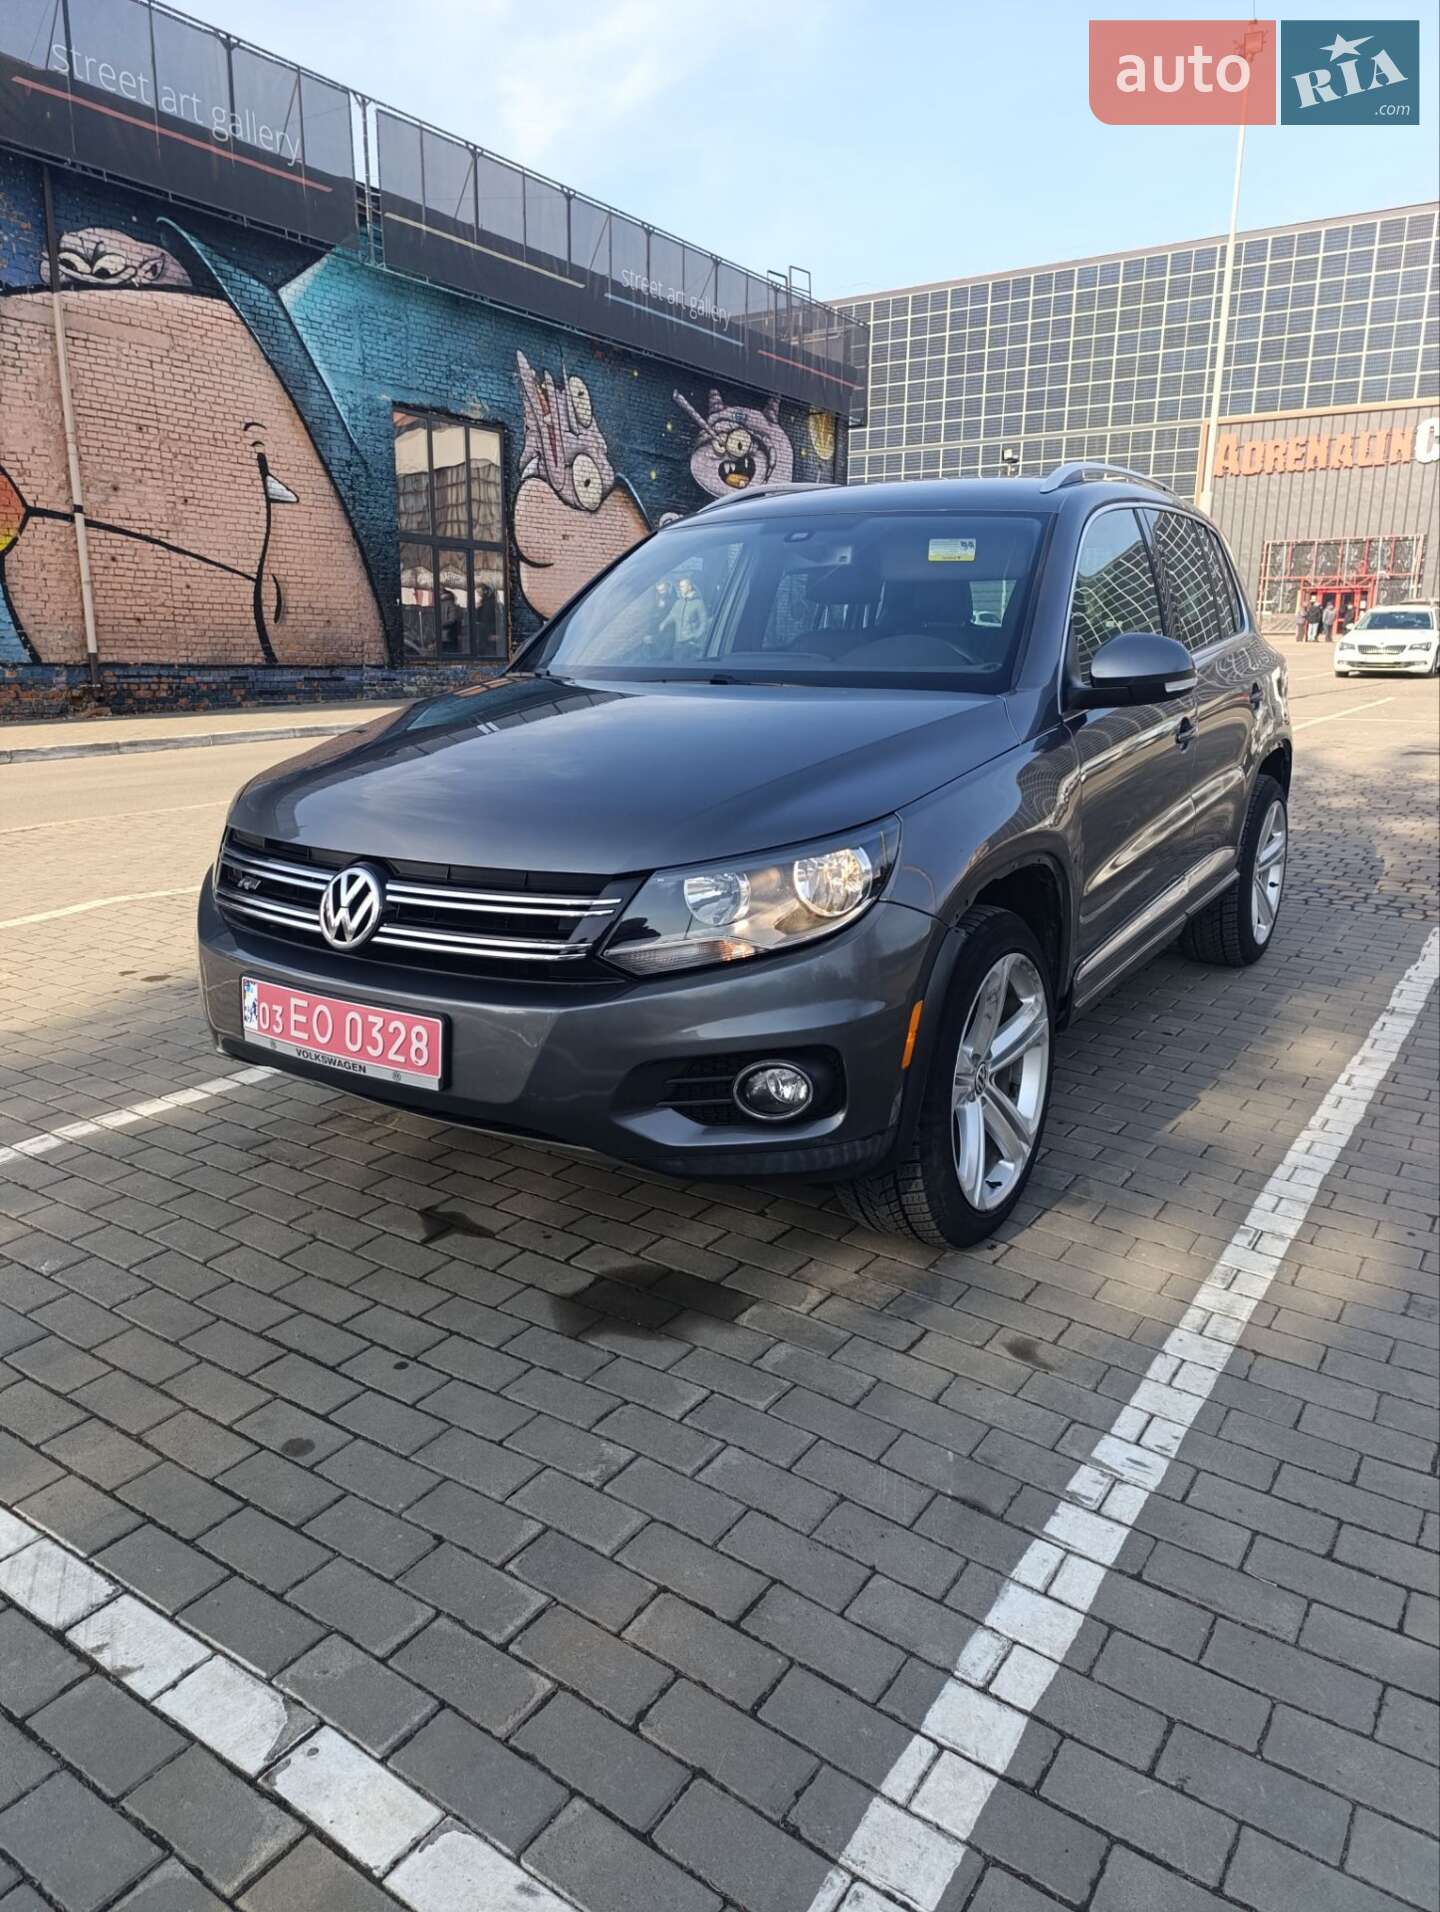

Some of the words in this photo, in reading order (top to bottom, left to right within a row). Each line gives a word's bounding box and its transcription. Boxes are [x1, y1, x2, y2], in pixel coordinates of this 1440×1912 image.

[52, 43, 152, 105] street
[161, 85, 204, 125] art
[211, 106, 303, 167] gallery
[621, 268, 663, 302] street
[667, 287, 686, 310] art
[689, 295, 731, 332] gallery
[1213, 426, 1415, 477] ADRENALIN
[295, 1047, 367, 1074] VOLKSWAGEN
[343, 1010, 430, 1068] 0328
